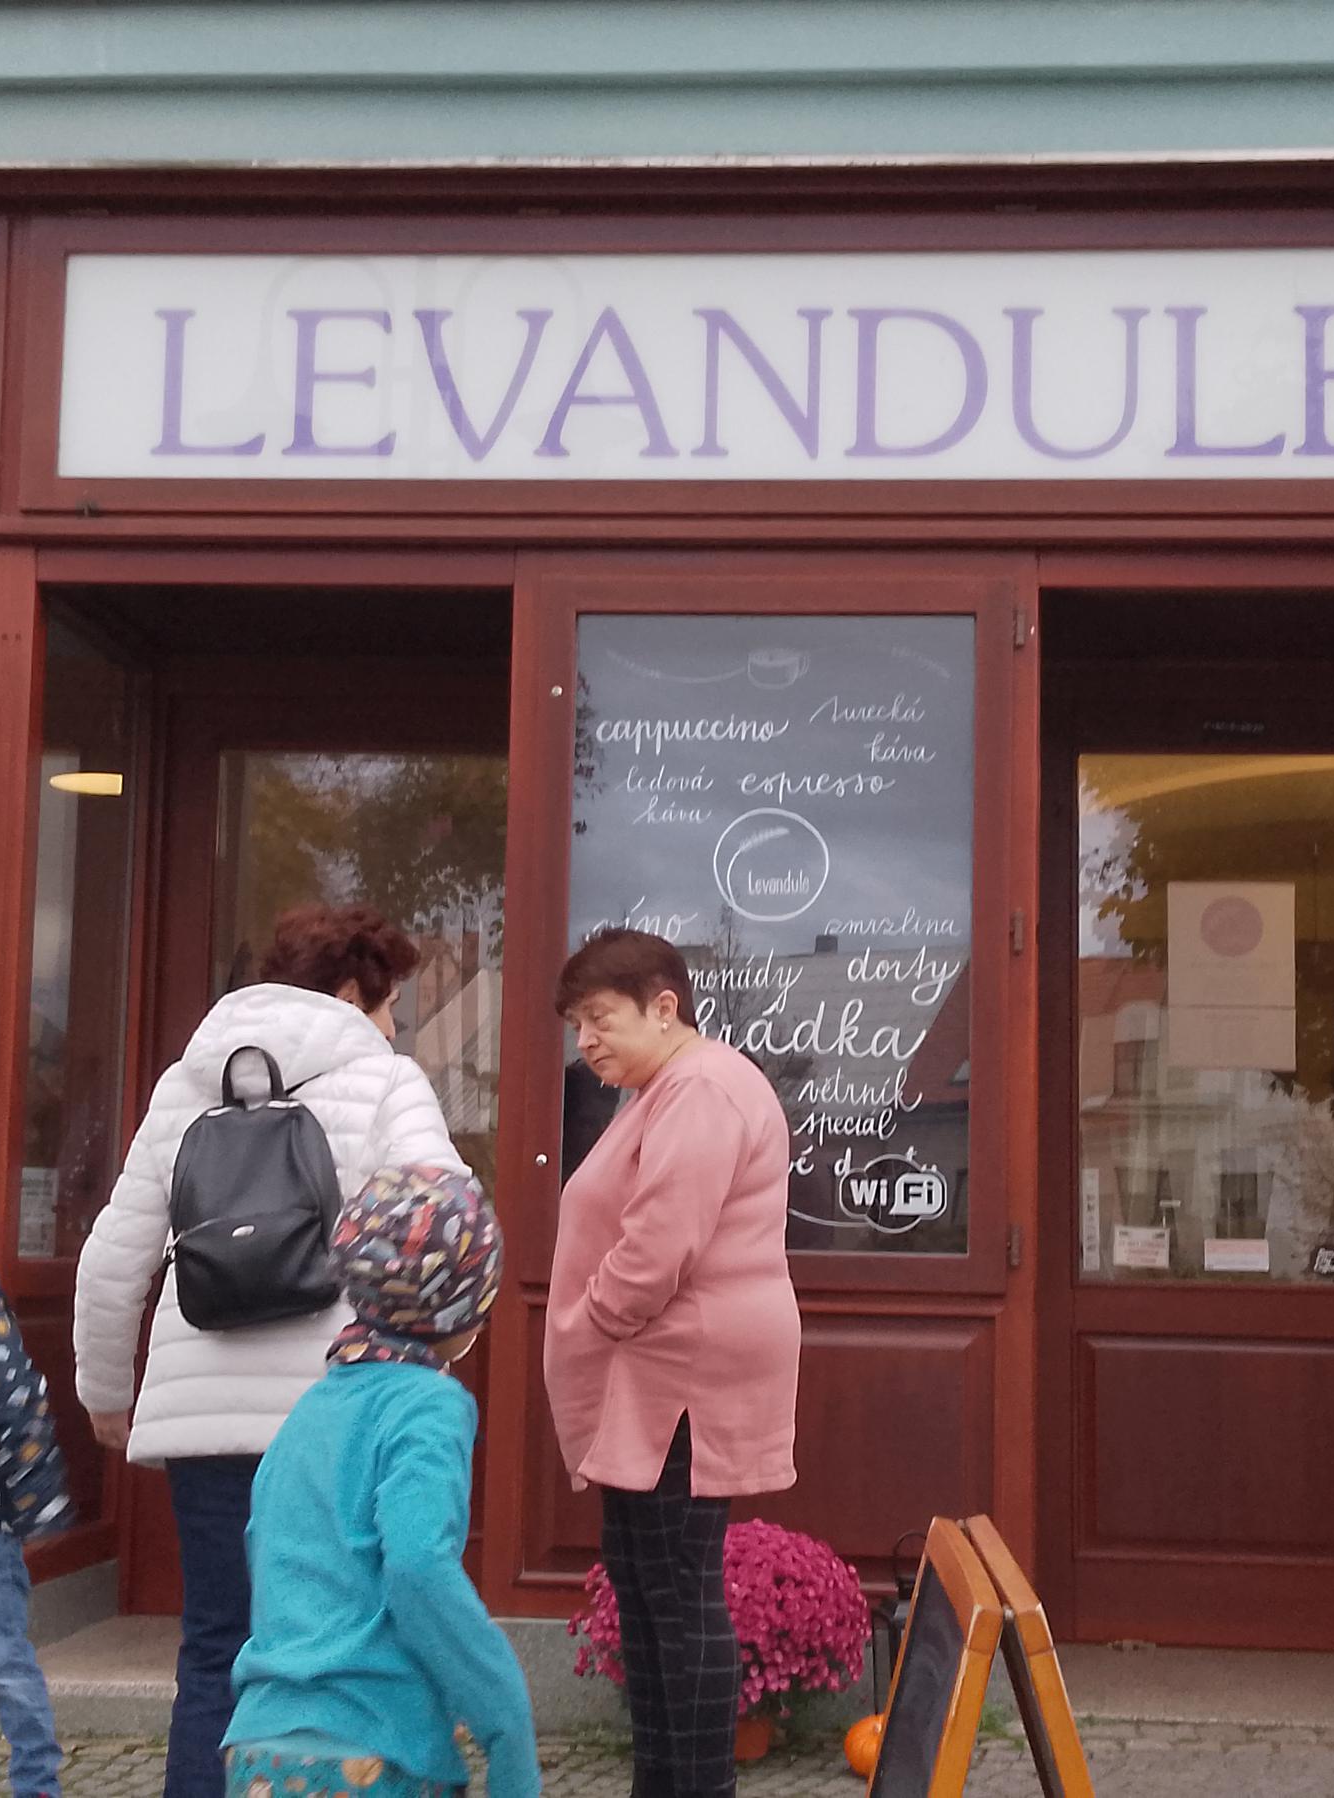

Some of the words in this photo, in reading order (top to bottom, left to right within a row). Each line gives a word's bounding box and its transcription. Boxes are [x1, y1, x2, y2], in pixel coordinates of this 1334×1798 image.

[595, 714, 789, 756] cappuccino
[865, 732, 937, 764] káva
[615, 764, 715, 795] ledová
[737, 769, 896, 804] espresso
[632, 797, 714, 825] káva
[747, 870, 810, 896] Levandule
[688, 949, 804, 1013] monády
[847, 945, 960, 1006] dorty
[693, 999, 928, 1061] hrádka
[798, 1067, 923, 1112] větrník
